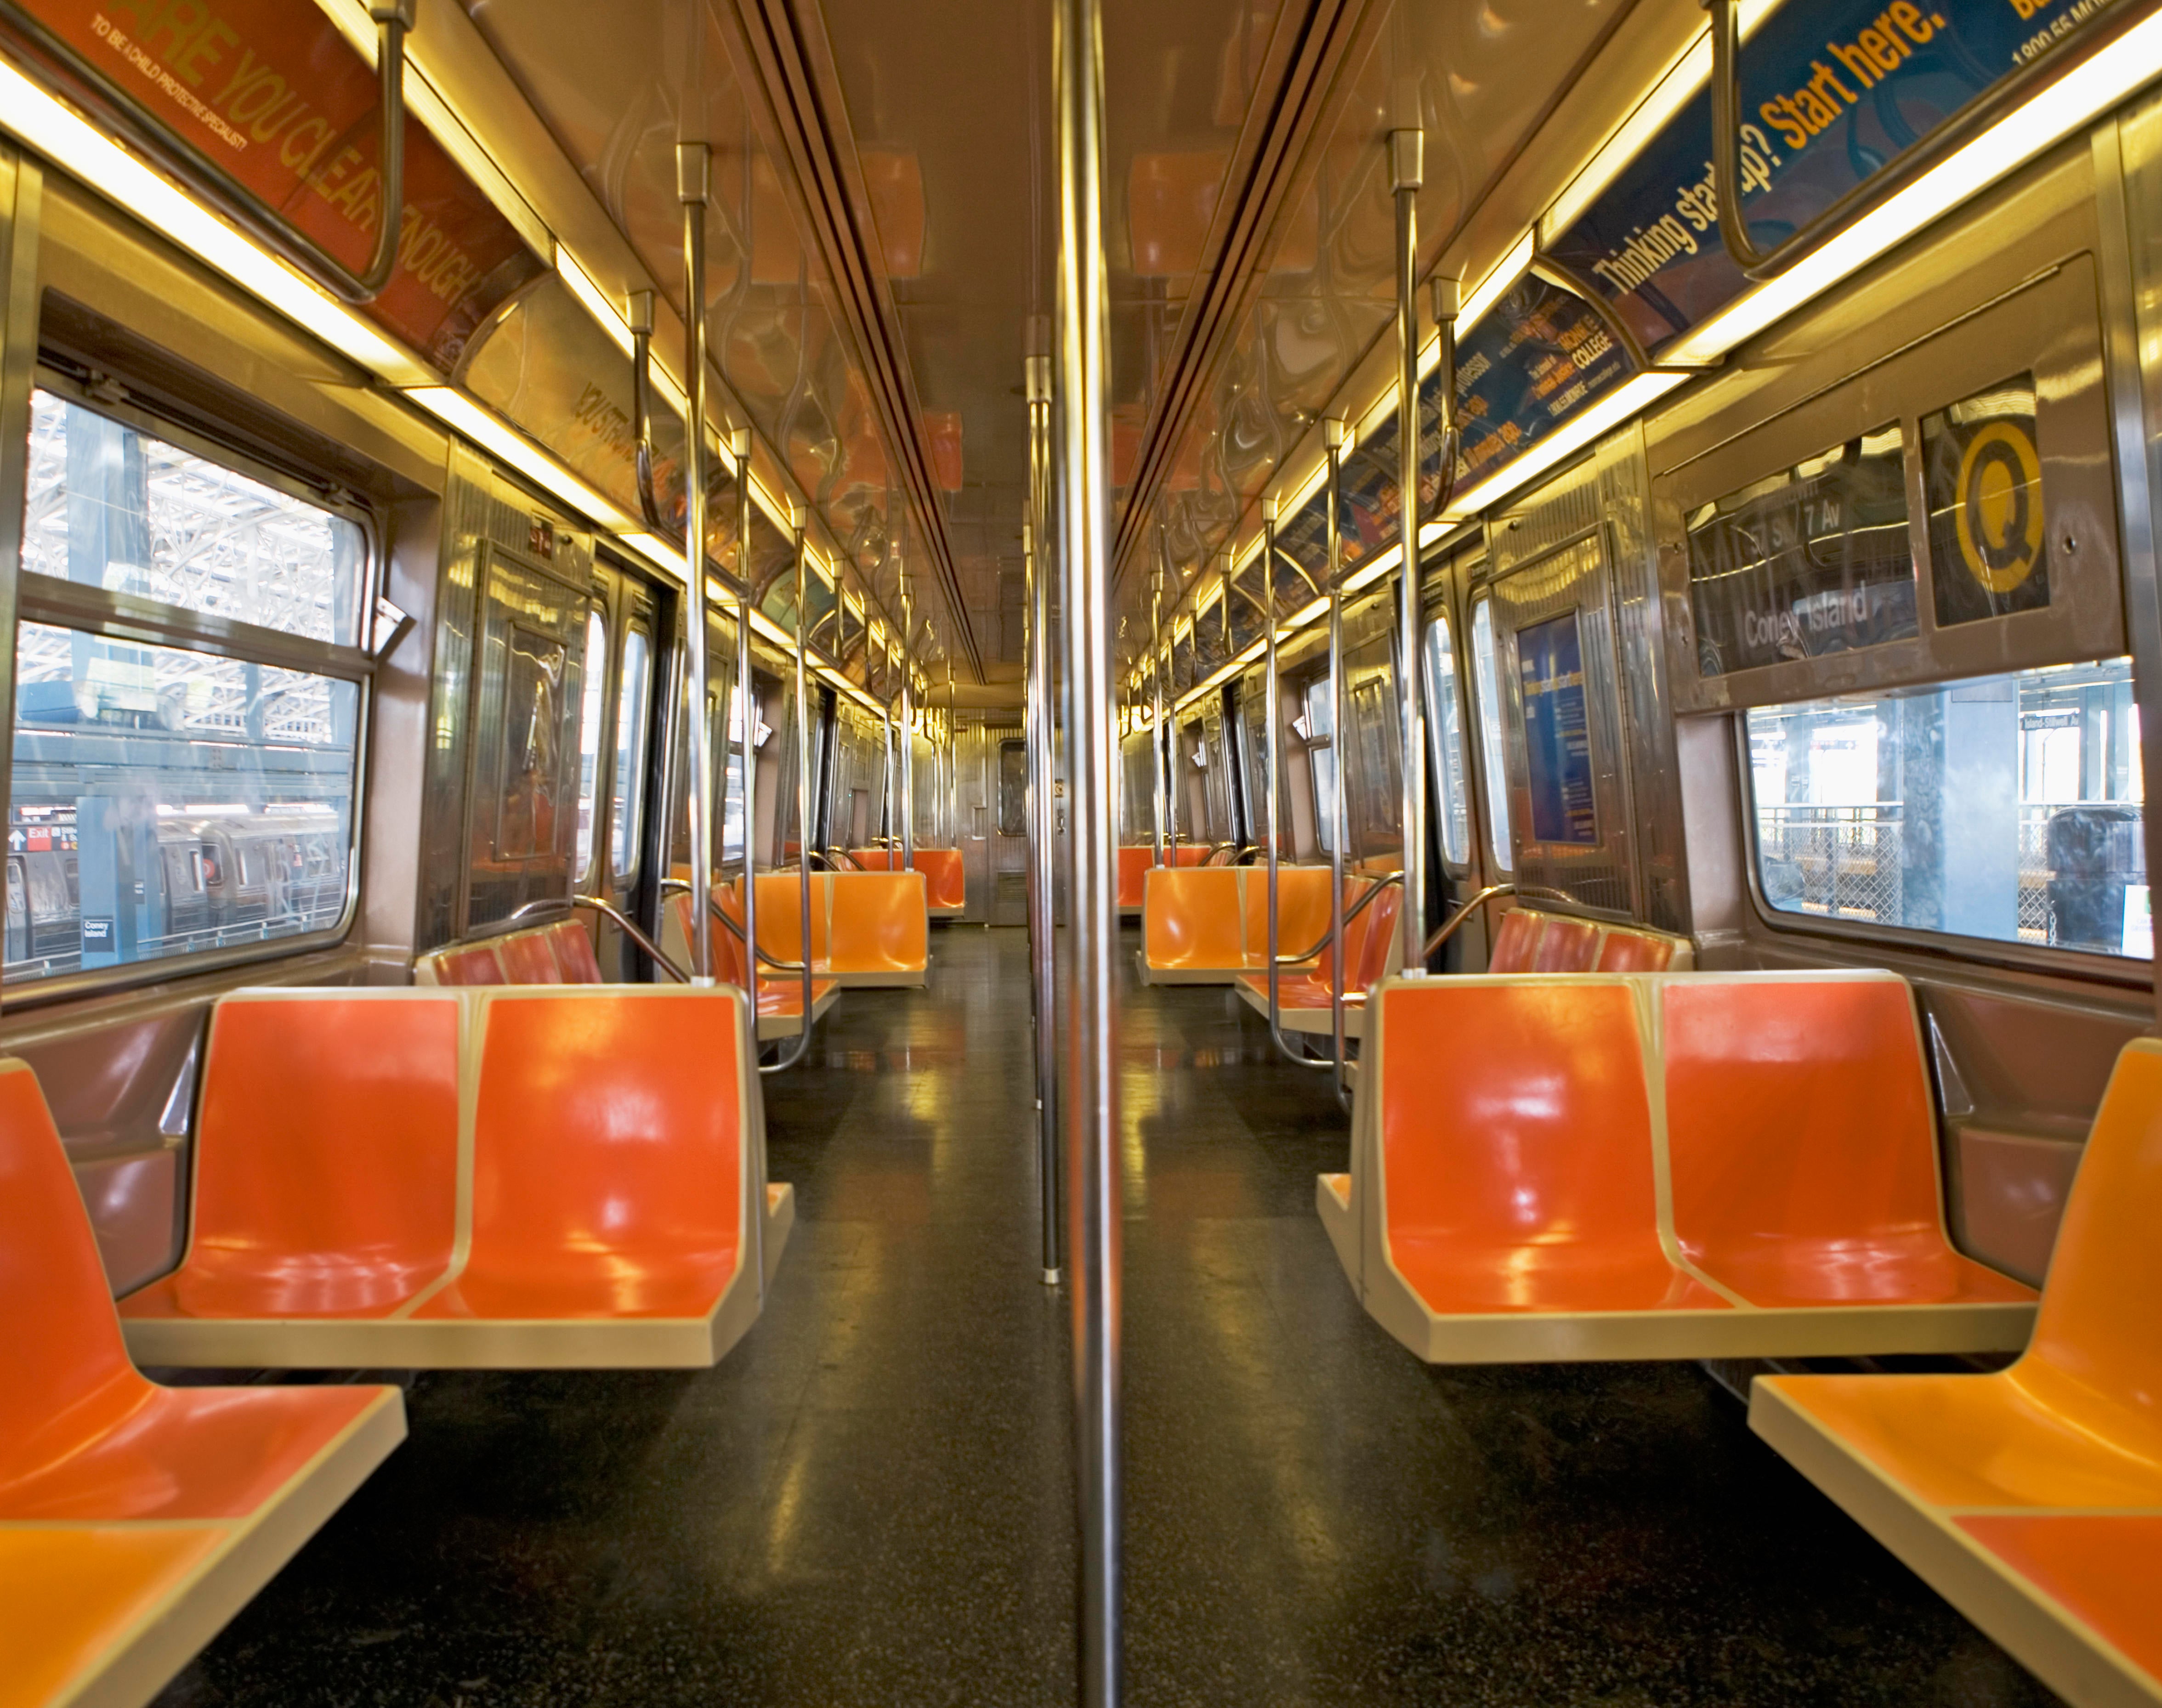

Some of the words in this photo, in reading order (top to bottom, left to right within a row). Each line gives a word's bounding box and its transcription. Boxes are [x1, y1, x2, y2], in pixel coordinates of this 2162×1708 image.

[91, 12, 111, 37] TO
[106, 28, 129, 52] BE
[127, 46, 161, 79] CHILD
[155, 71, 208, 119] PROTECTIVE
[211, 47, 309, 144] YOU
[1591, 214, 1698, 295] Thinking
[1760, 60, 1858, 151] Start
[1827, 0, 1947, 90] here.
[1572, 329, 1613, 369] COLLEGE
[1821, 498, 1839, 532] Av
[1746, 609, 1800, 648] Coney
[1806, 580, 1868, 632] Island
[28, 827, 50, 838] Exit
